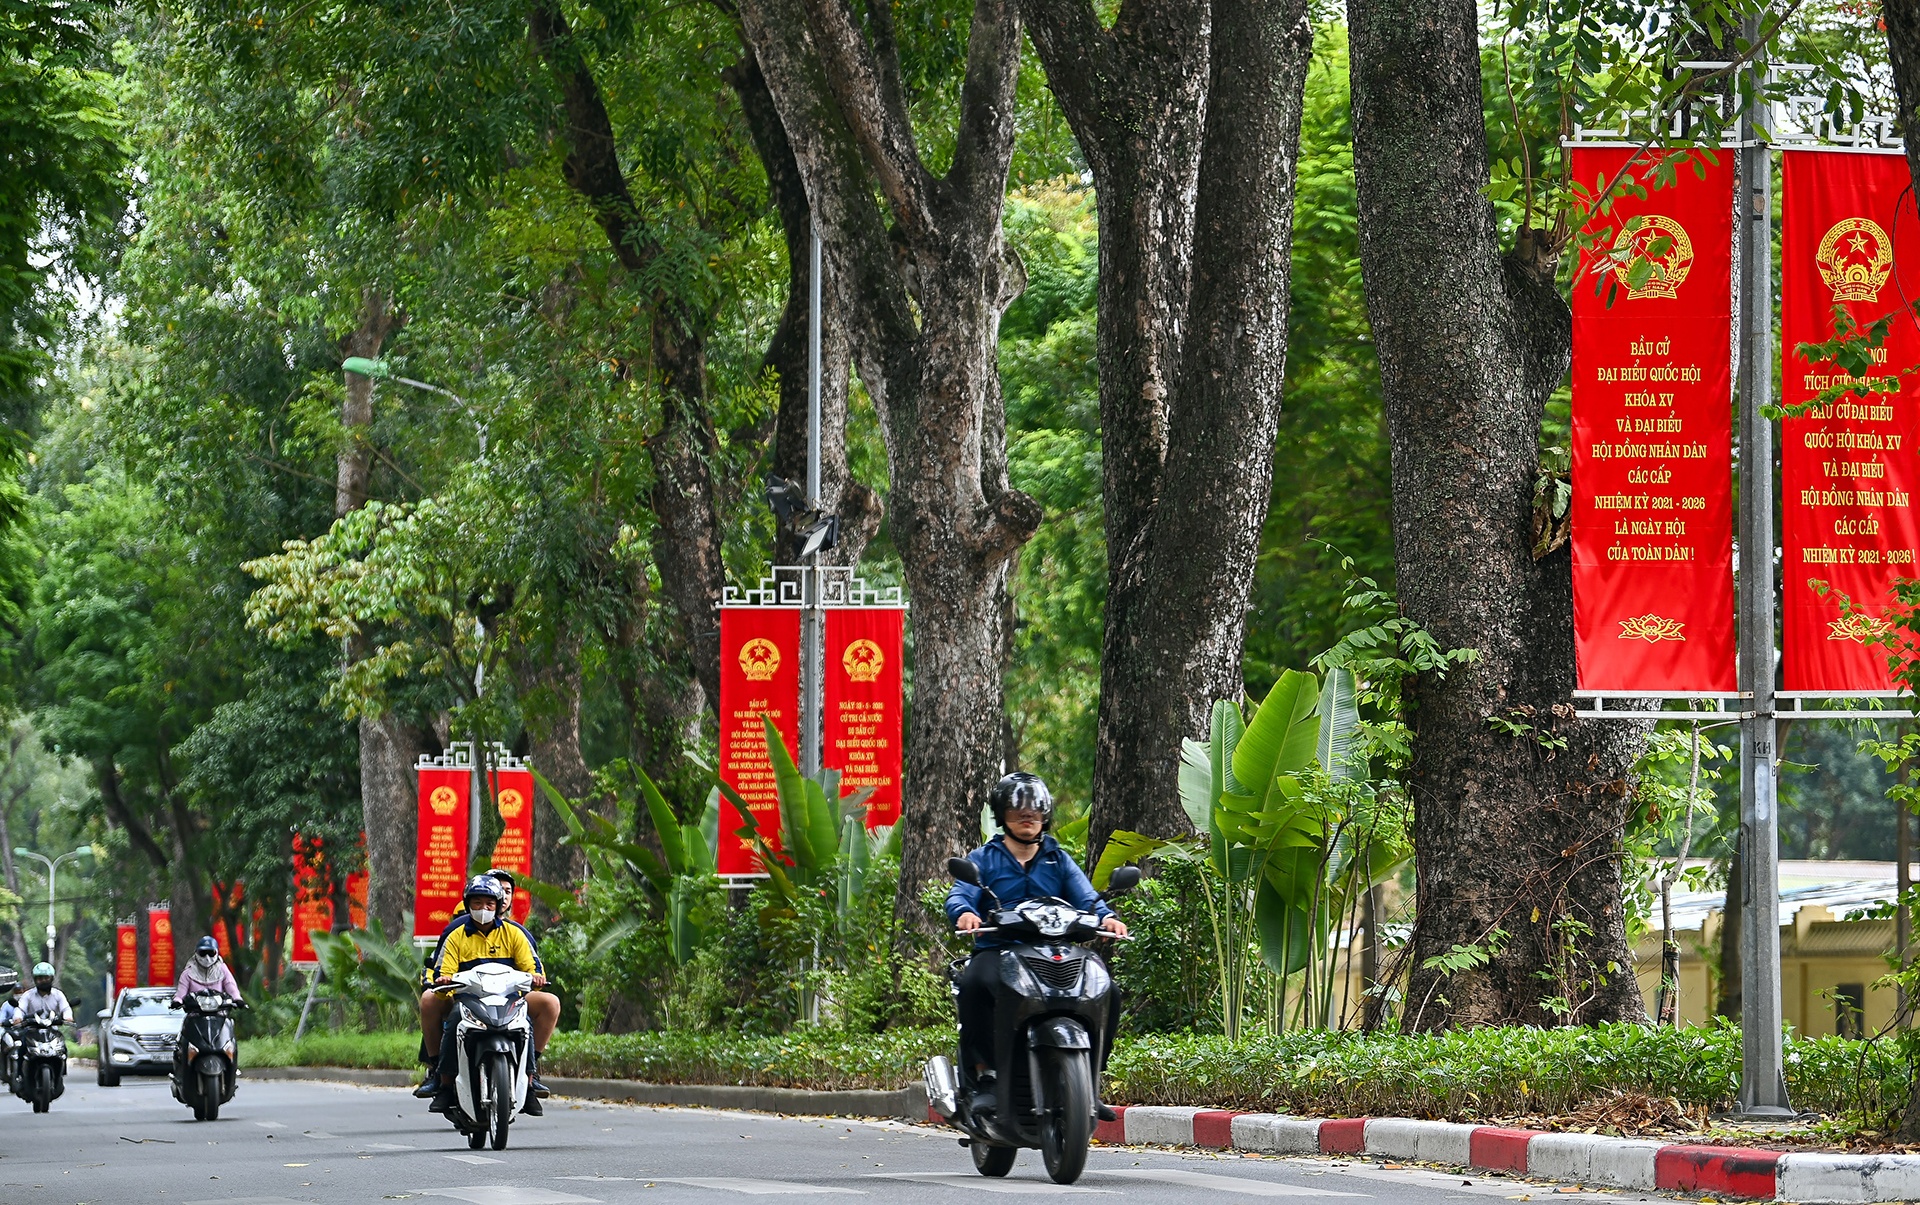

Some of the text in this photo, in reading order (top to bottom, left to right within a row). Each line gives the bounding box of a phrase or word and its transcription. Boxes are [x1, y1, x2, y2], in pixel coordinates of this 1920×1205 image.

[1631, 335, 1670, 355] BẦU CỬ
[1598, 359, 1701, 384] ĐẠI BIỂU QUỐC HỘI
[1804, 370, 1829, 390] TÍCH
[1625, 389, 1674, 407] KHÓA XV
[1836, 397, 1850, 419] CỬ
[1852, 405, 1868, 423] ĐẠI
[1870, 396, 1893, 421] BIỂU
[1616, 410, 1682, 435] VÀ ĐẠI BIỂU
[1592, 438, 1707, 461] HỘI ĐỒNG NHÂN DÂN
[1804, 426, 1901, 451] QUỐC HỘI KHÓA XV
[1628, 464, 1671, 483] CÁC CẤP
[1823, 453, 1884, 480] VÀ ĐẠI BIỂU
[1594, 491, 1632, 512] NHIỆM
[1634, 492, 1649, 509] KỲ
[1652, 497, 1674, 510] 2021
[1682, 497, 1705, 510] 2026
[1801, 483, 1909, 509] HỘI ĐỒNG NHÂN DÂN
[1615, 517, 1685, 538] LÀ NGÀY HỘI
[1834, 513, 1879, 535] CÁC CẤP
[1607, 541, 1629, 560] CỦA
[1632, 543, 1662, 560] TOÀN
[1665, 543, 1688, 560] DÂN
[1803, 544, 1837, 567] NHIỆM
[1840, 544, 1855, 563] KỲ
[1858, 549, 1880, 564] 2021
[1887, 550, 1911, 564] 2026
